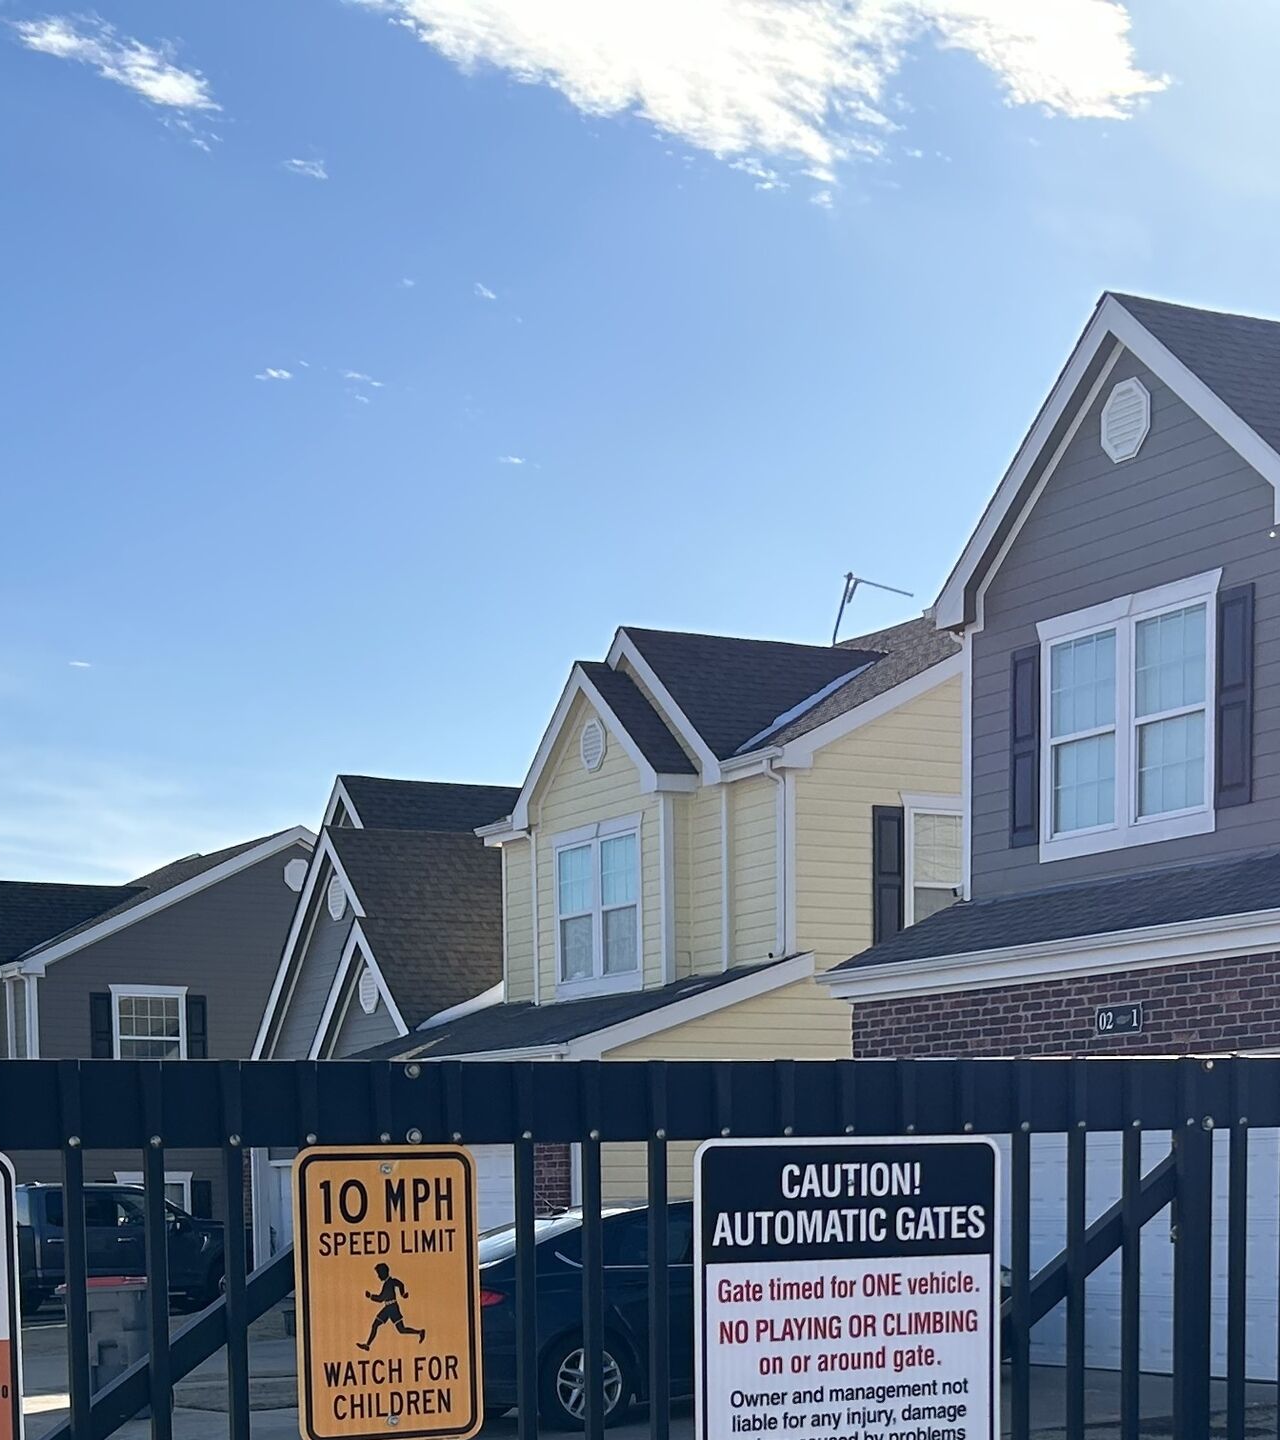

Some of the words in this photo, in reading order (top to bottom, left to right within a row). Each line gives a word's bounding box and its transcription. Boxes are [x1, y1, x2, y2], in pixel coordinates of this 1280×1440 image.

[1100, 1012, 1113, 1030] 02
[1131, 1009, 1138, 1027] 1
[781, 1162, 921, 1198] CAUTION!
[319, 1179, 368, 1225] 10
[385, 1177, 453, 1223] MPH
[712, 1207, 887, 1247] AUTOMATIC
[895, 1205, 985, 1242] GATES
[319, 1231, 391, 1257] SPEED
[401, 1228, 456, 1254] LIMIT
[718, 1279, 763, 1303] Gate
[769, 1276, 824, 1301] timed
[830, 1275, 857, 1298] for
[862, 1273, 902, 1298] ONE
[908, 1271, 980, 1295] vehicle.
[719, 1320, 749, 1344] NO
[756, 1315, 842, 1342] PLAYING
[849, 1314, 877, 1338] OR
[883, 1309, 978, 1336] CLIMBING
[324, 1358, 403, 1388] WATCH
[414, 1355, 458, 1382] FOR
[759, 1355, 783, 1375] on
[791, 1353, 810, 1373] or
[817, 1346, 886, 1371] around
[893, 1344, 942, 1372] gate.
[333, 1388, 451, 1420] CHILDREN
[730, 1390, 787, 1408] Owner
[792, 1386, 824, 1404] and
[829, 1380, 938, 1403] management
[942, 1377, 969, 1395] not
[732, 1414, 778, 1433] liable
[782, 1411, 807, 1429] for
[811, 1412, 842, 1432] any
[847, 1407, 898, 1428] injury,
[901, 1403, 967, 1425] damage
